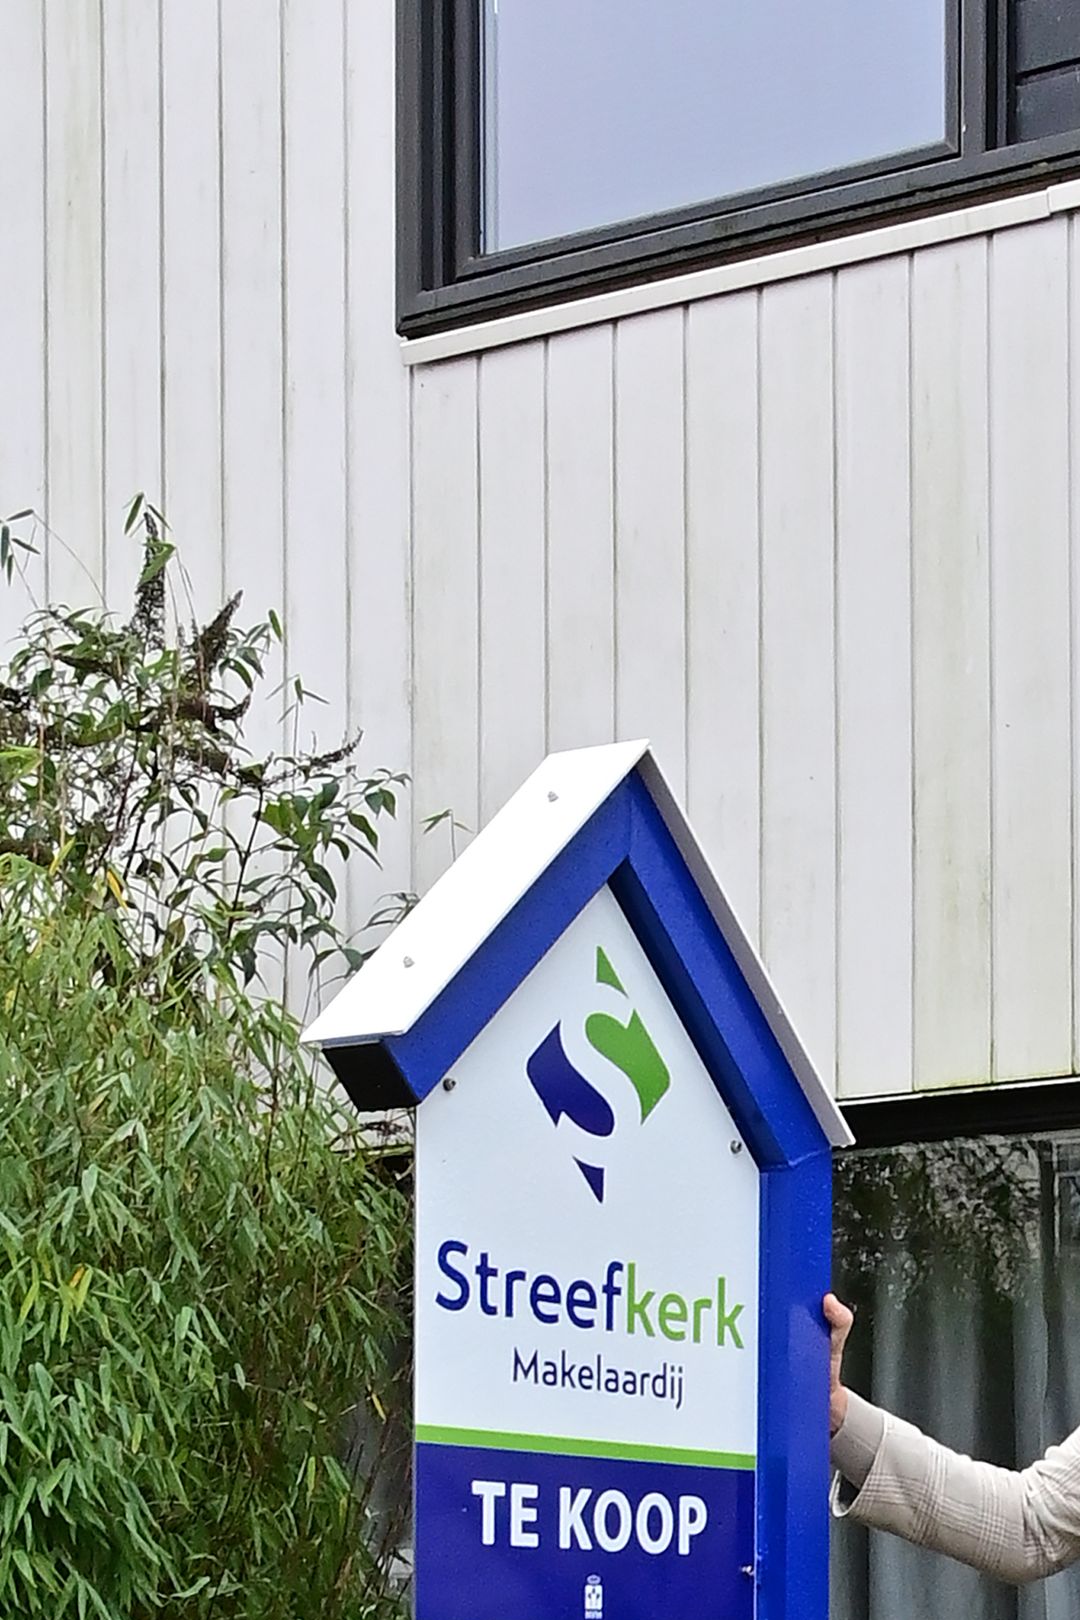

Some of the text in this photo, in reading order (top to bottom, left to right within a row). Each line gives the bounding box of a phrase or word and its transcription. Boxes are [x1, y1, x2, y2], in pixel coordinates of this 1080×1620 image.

[434, 1239, 746, 1349] Streefkerk
[512, 1347, 684, 1409] Makelaardij
[471, 1480, 708, 1555] TE KOOP
